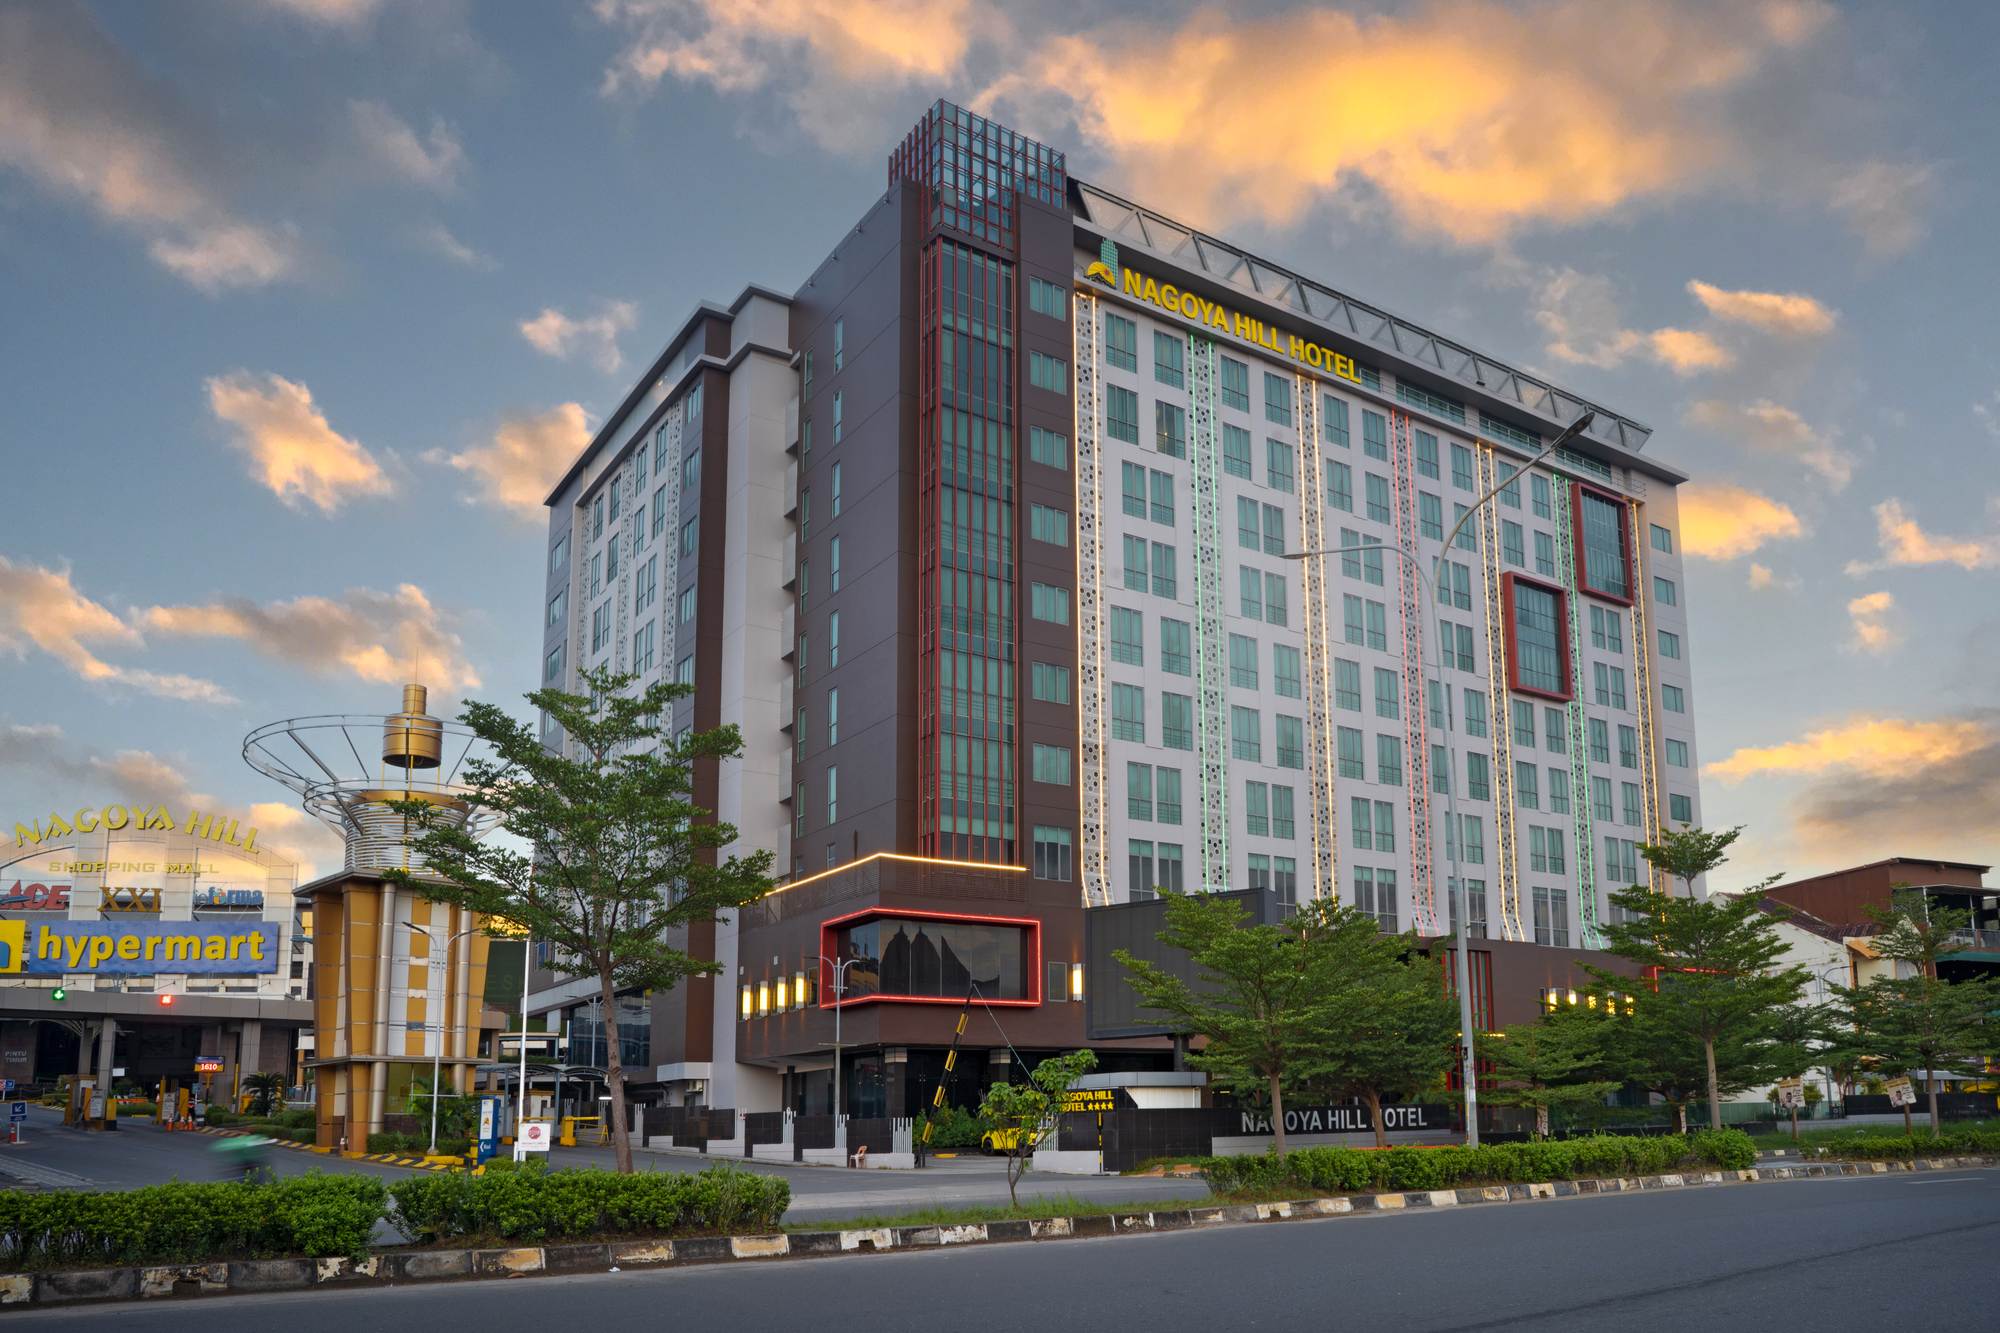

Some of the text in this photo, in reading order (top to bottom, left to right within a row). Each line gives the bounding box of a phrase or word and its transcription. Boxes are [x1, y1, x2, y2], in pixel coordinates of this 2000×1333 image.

[1124, 268, 1362, 384] NAGOYA HILL HOTEL
[14, 804, 176, 848] NAGOYA
[50, 861, 220, 874] SHOPPING MALL
[0, 880, 72, 910] ACE
[97, 887, 163, 913] XXI
[37, 925, 265, 968] hypermart
[1095, 1090, 1114, 1100] HILL
[1328, 1109, 1367, 1130] HILL
